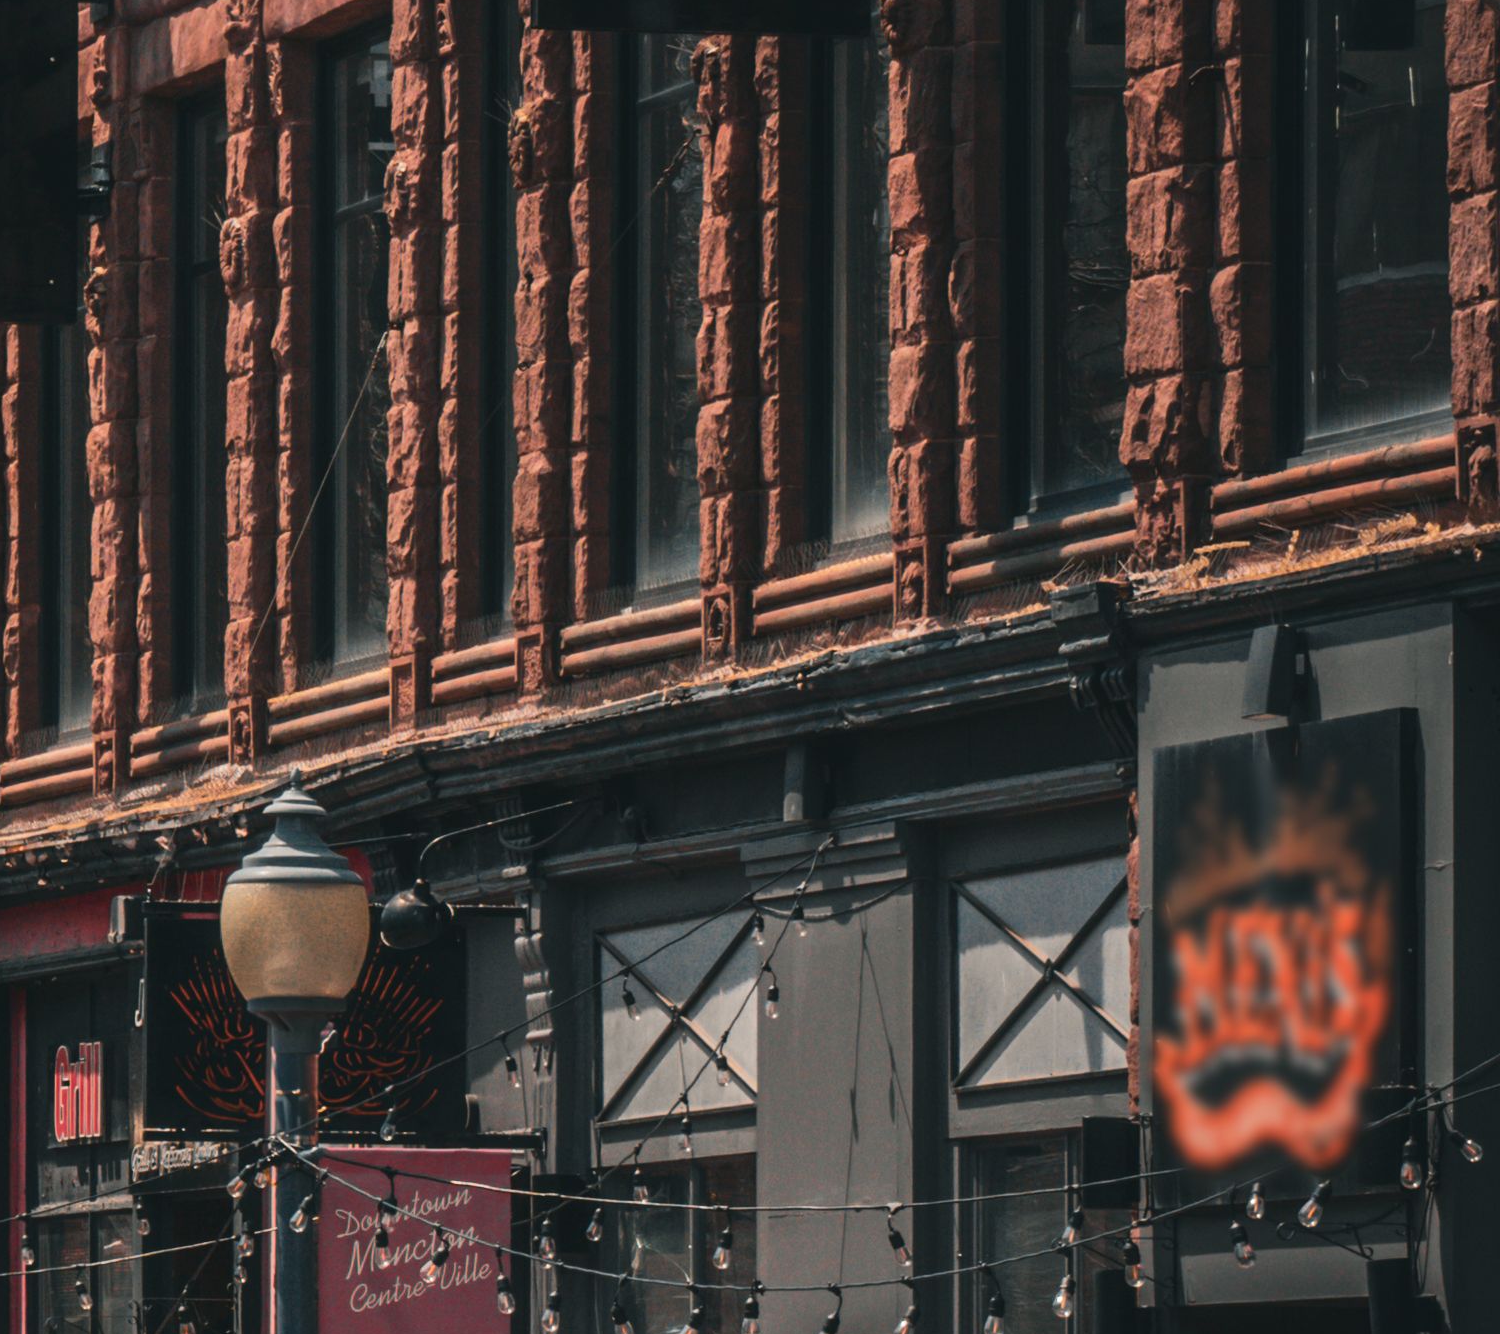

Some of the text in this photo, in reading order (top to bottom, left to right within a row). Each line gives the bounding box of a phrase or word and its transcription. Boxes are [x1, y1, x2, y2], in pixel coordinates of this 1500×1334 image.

[54, 1040, 102, 1143] Grill
[336, 1188, 473, 1239] Dontown
[346, 1225, 479, 1280] Mncton
